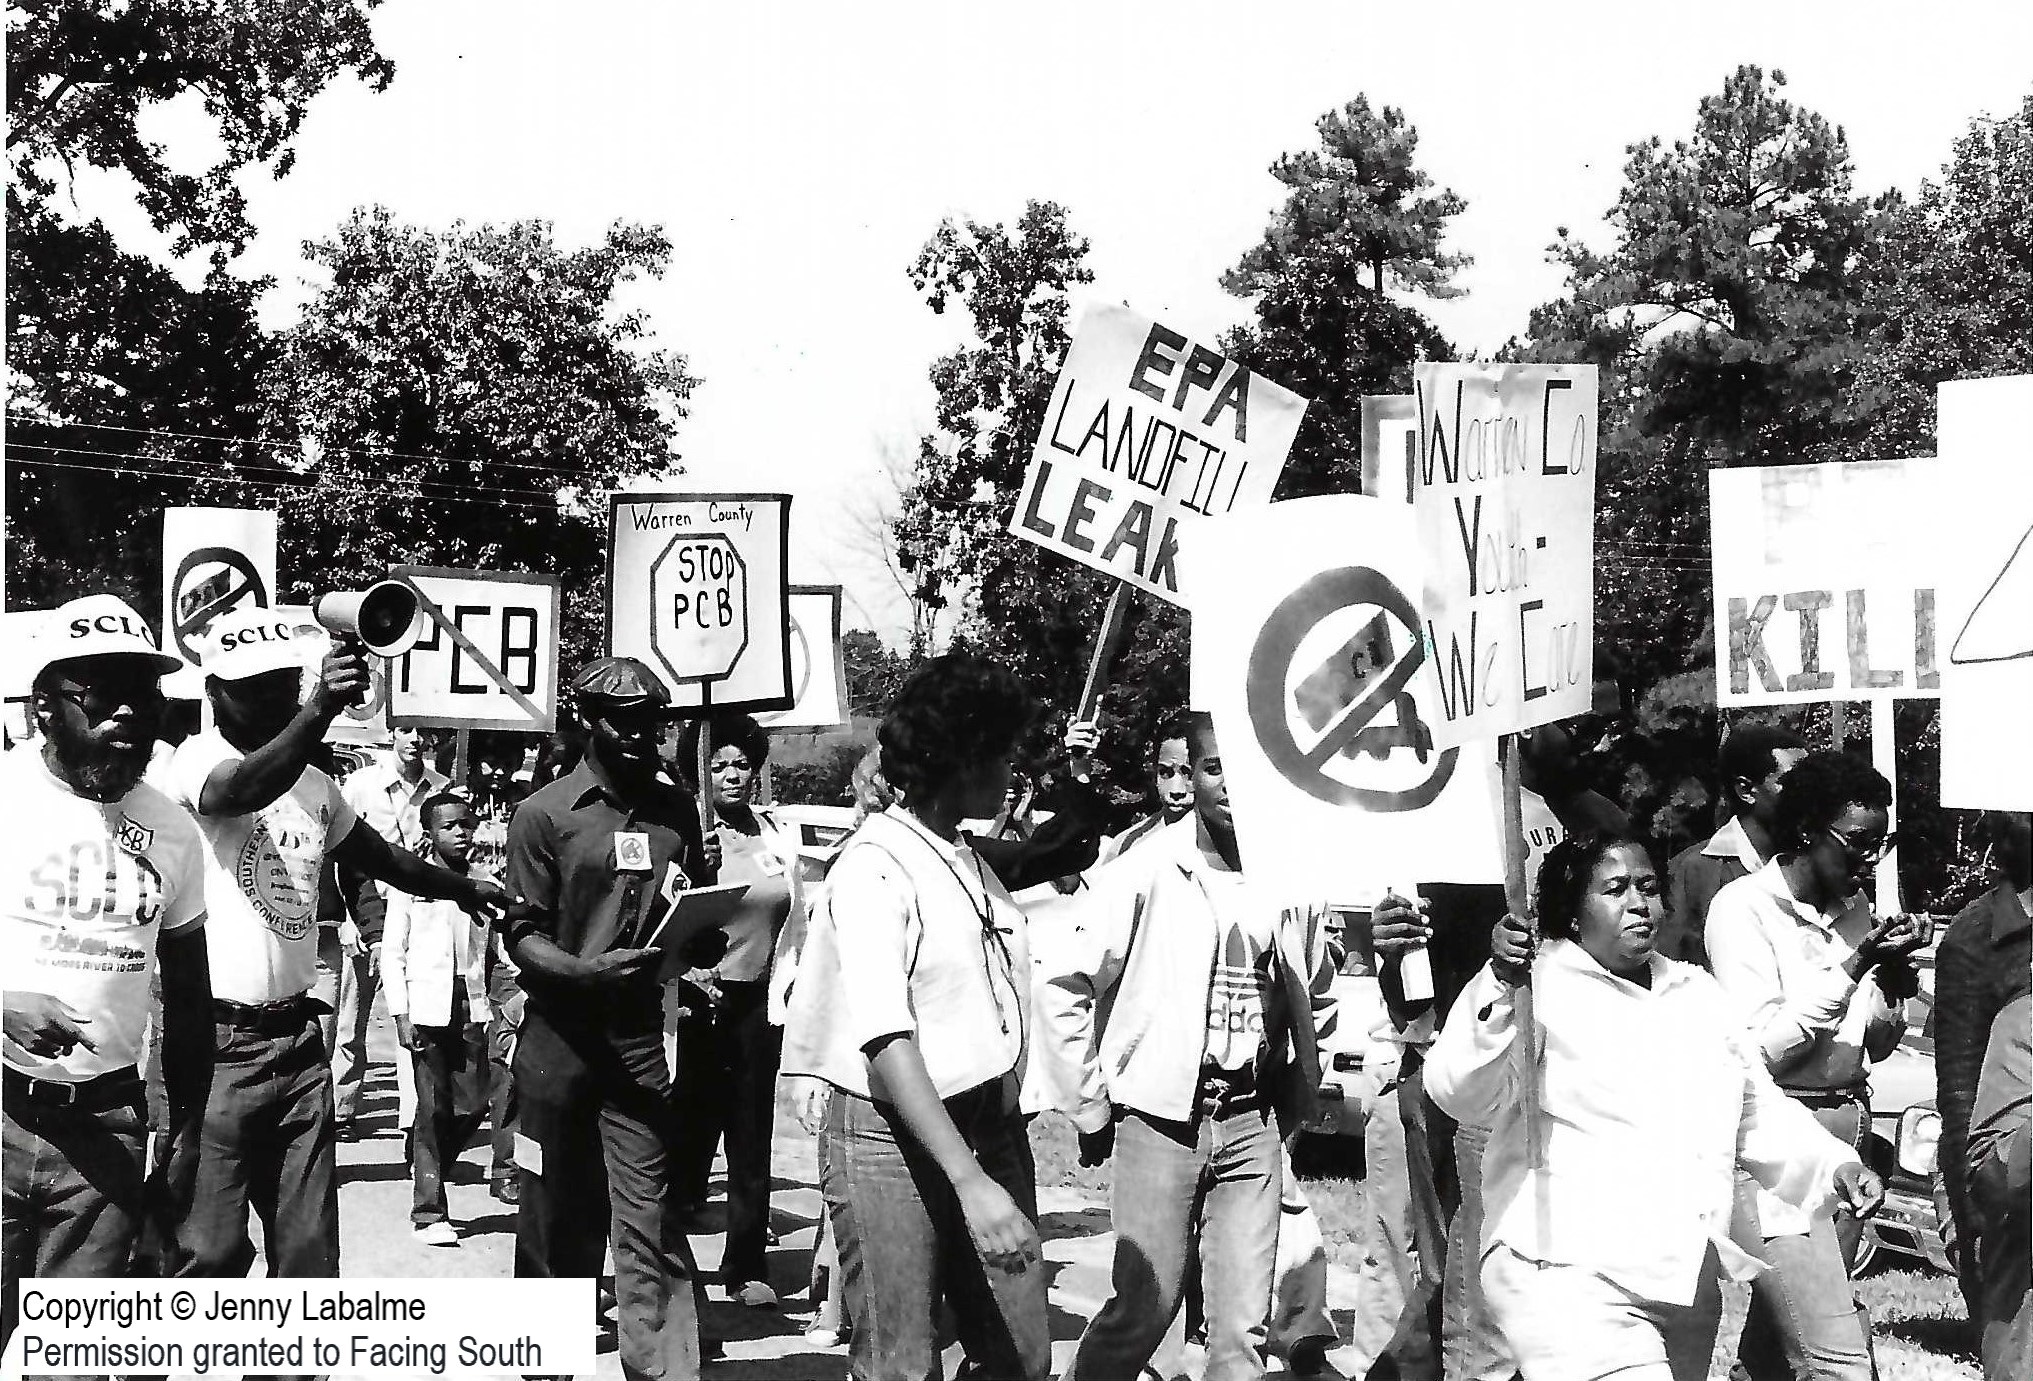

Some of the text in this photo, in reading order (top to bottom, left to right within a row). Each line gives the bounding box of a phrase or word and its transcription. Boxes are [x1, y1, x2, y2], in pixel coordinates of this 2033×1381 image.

[1129, 322, 1251, 443] EPA
[630, 501, 754, 532] Warren County
[1021, 460, 1179, 593] LEAK
[675, 588, 733, 630] PCB
[679, 544, 736, 592] STOP
[220, 622, 290, 653] SCLC
[402, 603, 538, 695] PCB
[1427, 611, 1500, 722] We
[1728, 588, 1941, 694] KILL
